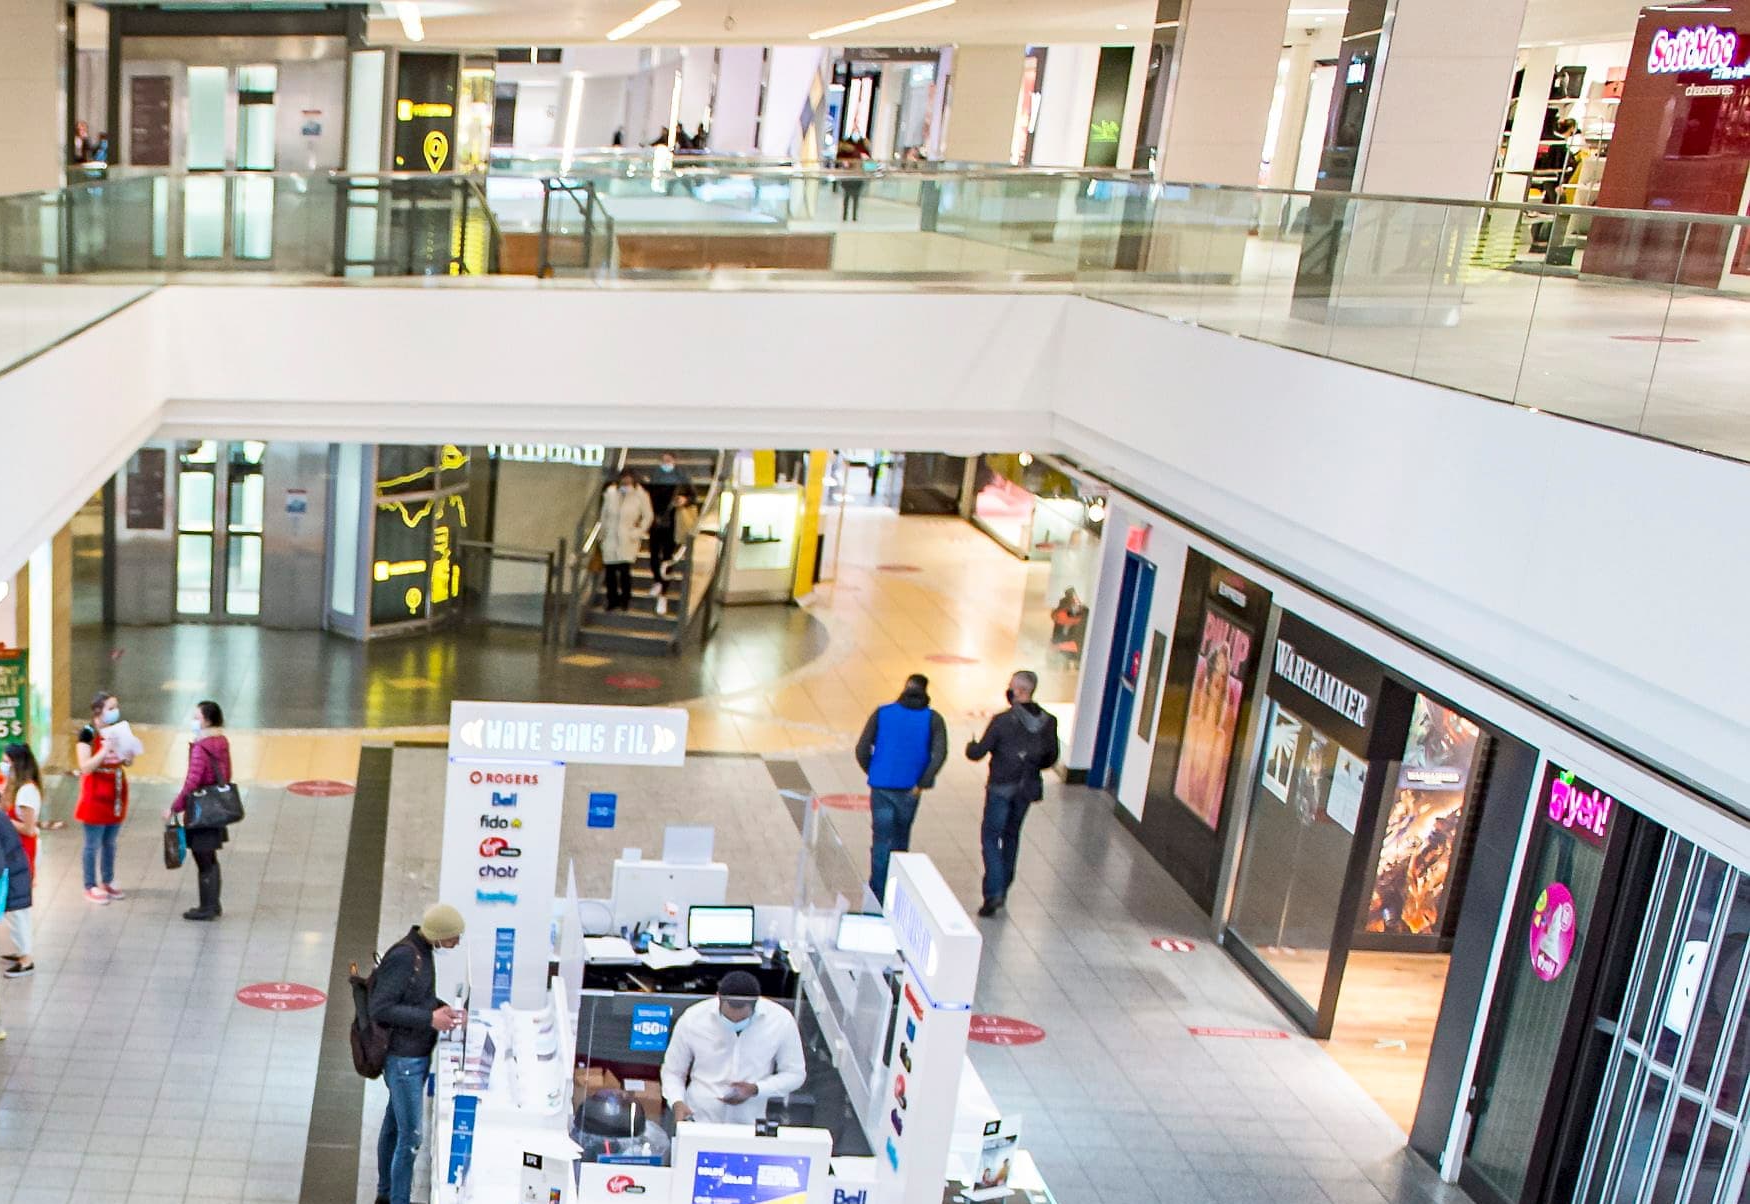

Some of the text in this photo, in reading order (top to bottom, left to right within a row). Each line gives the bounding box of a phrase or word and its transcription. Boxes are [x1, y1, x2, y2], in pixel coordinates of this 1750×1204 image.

[1275, 639, 1368, 727] WARHAMMER
[486, 720, 649, 755] WAVE SANS FIL
[486, 773, 539, 785] ROGERS
[480, 814, 509, 829] fido
